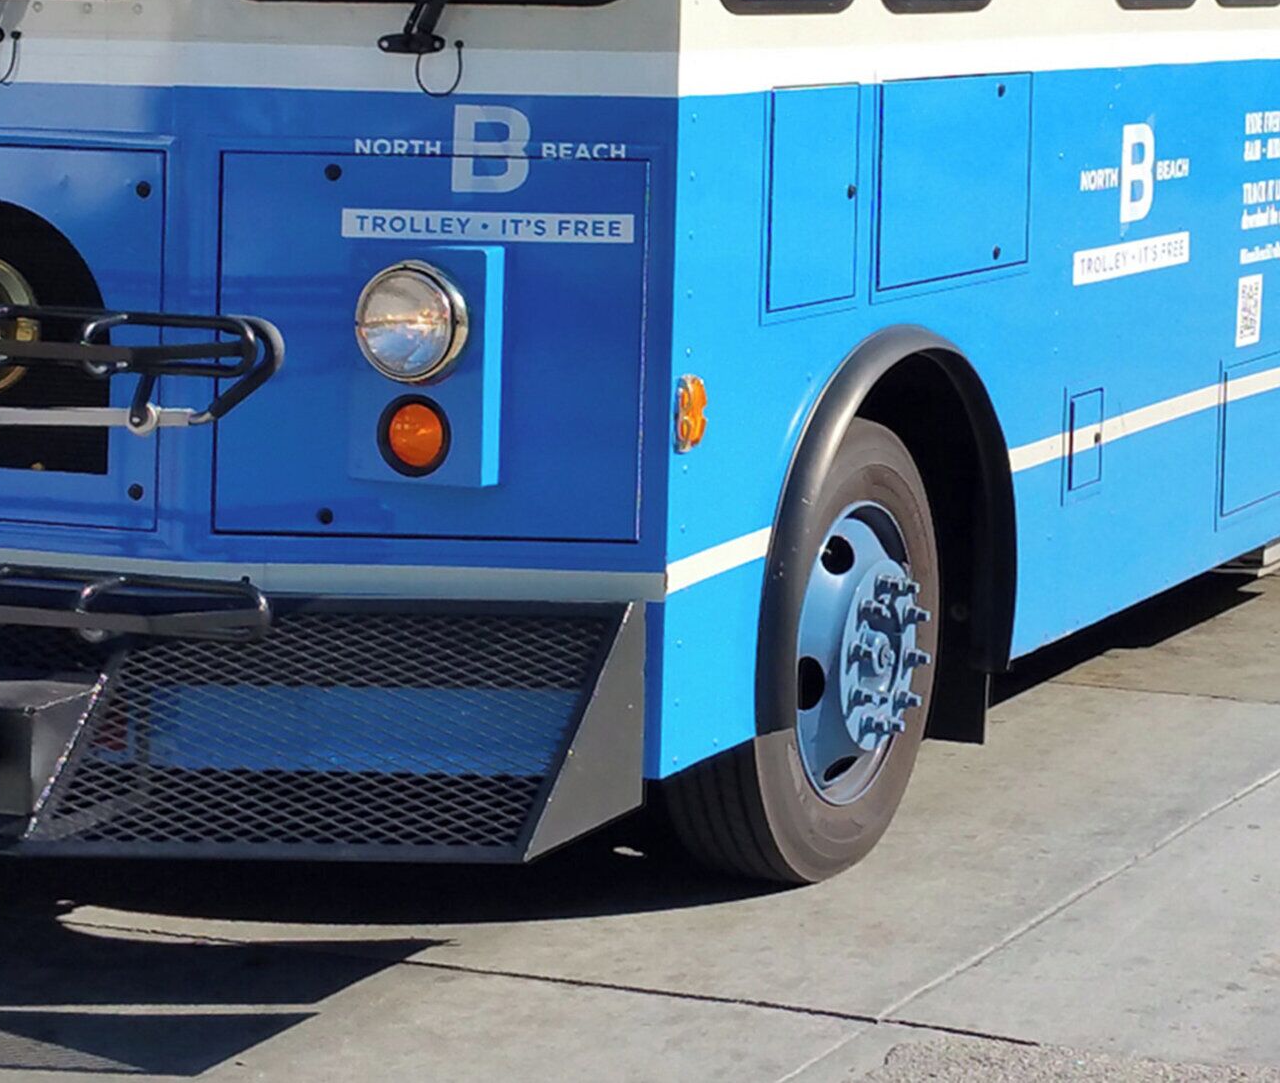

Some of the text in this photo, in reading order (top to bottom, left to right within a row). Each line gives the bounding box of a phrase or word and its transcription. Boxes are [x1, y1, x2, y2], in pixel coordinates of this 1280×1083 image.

[354, 103, 627, 194] NORTH B BEACH
[1080, 122, 1190, 224] NORTH B BEACH
[356, 214, 623, 238] TROLLEY IT'S FREE
[1079, 251, 1127, 276] TROLLEY
[1161, 238, 1186, 258] FREE
